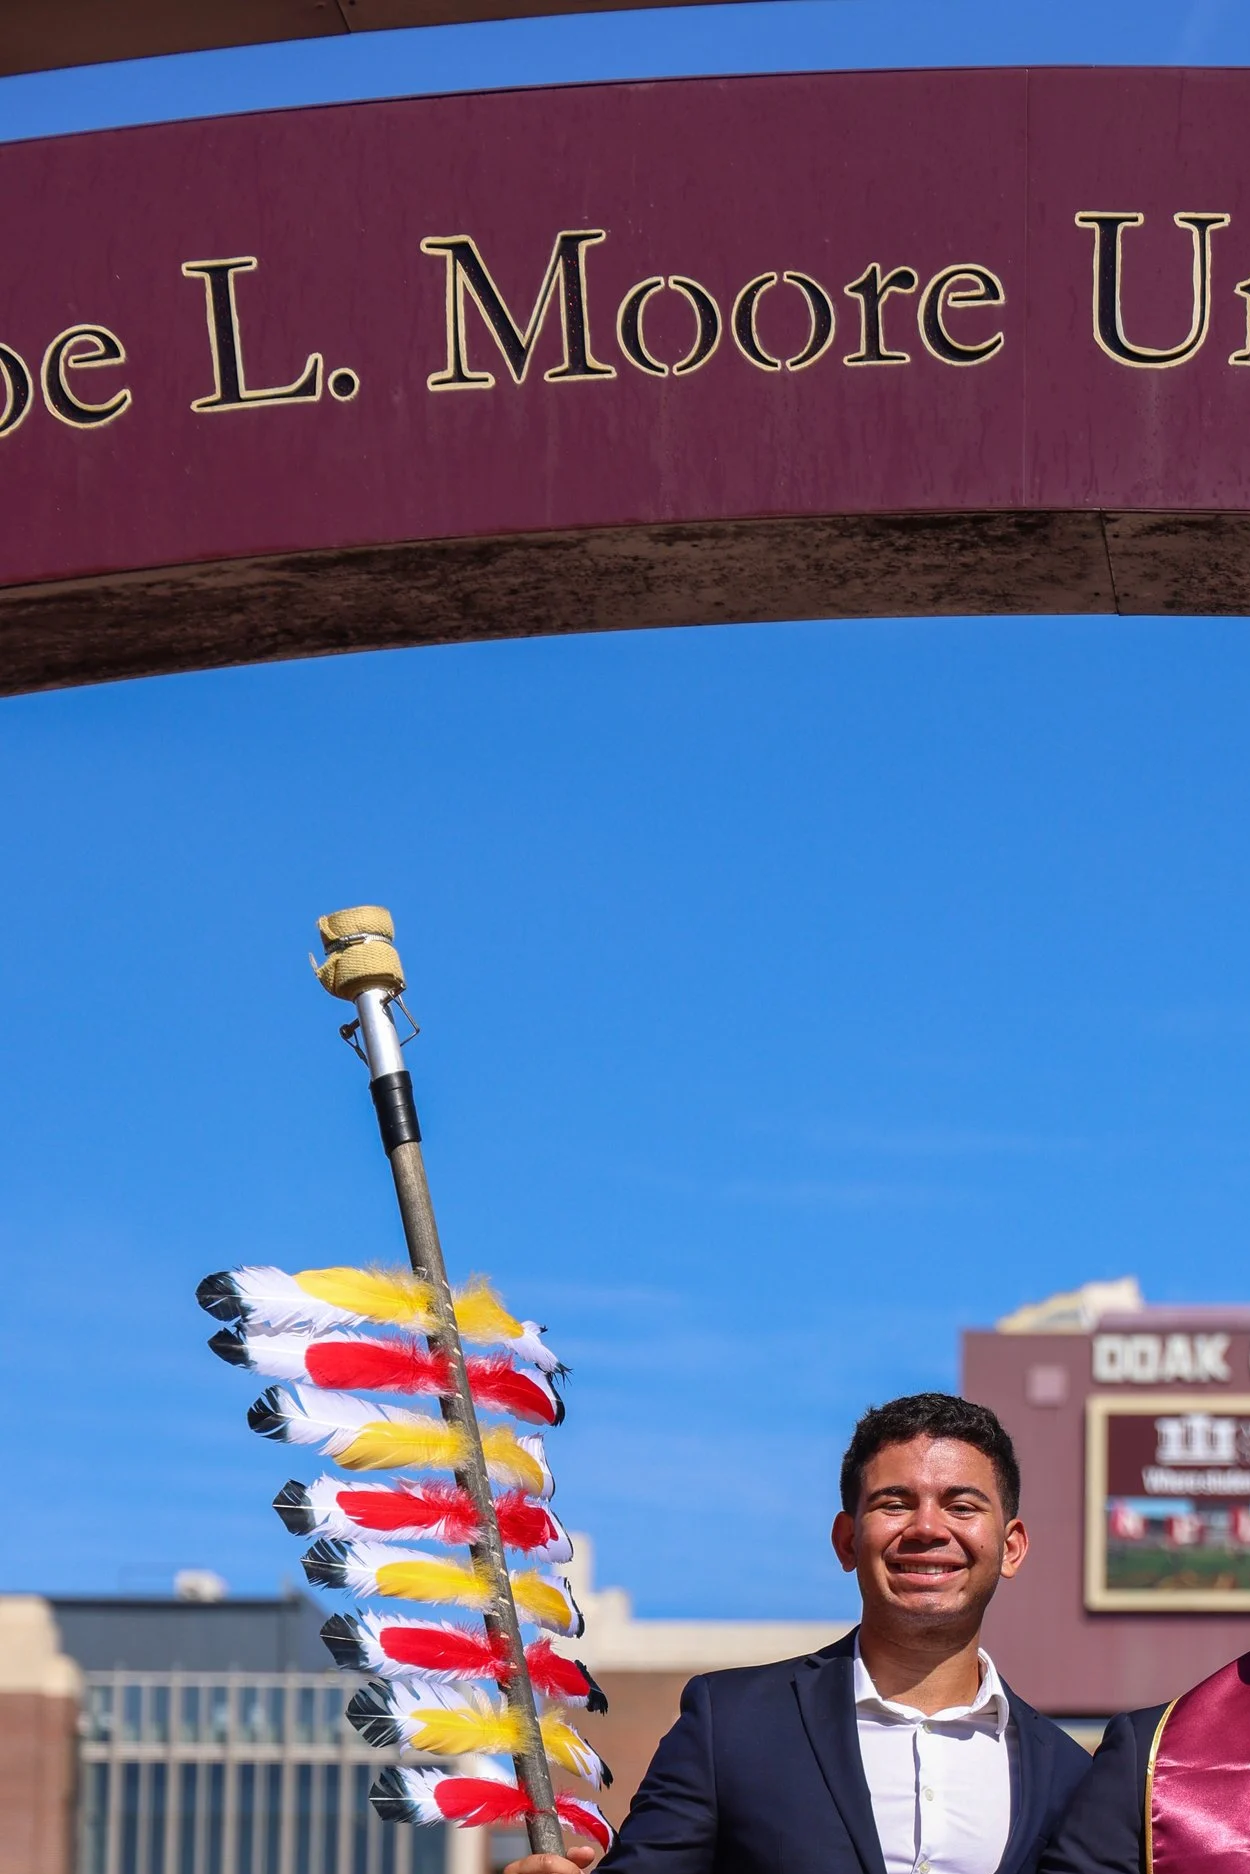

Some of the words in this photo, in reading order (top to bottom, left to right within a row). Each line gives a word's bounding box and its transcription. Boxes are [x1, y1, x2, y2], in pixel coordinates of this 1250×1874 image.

[183, 255, 361, 412] L.
[420, 229, 1005, 389] Moore
[1093, 1333, 1233, 1383] DOAK
